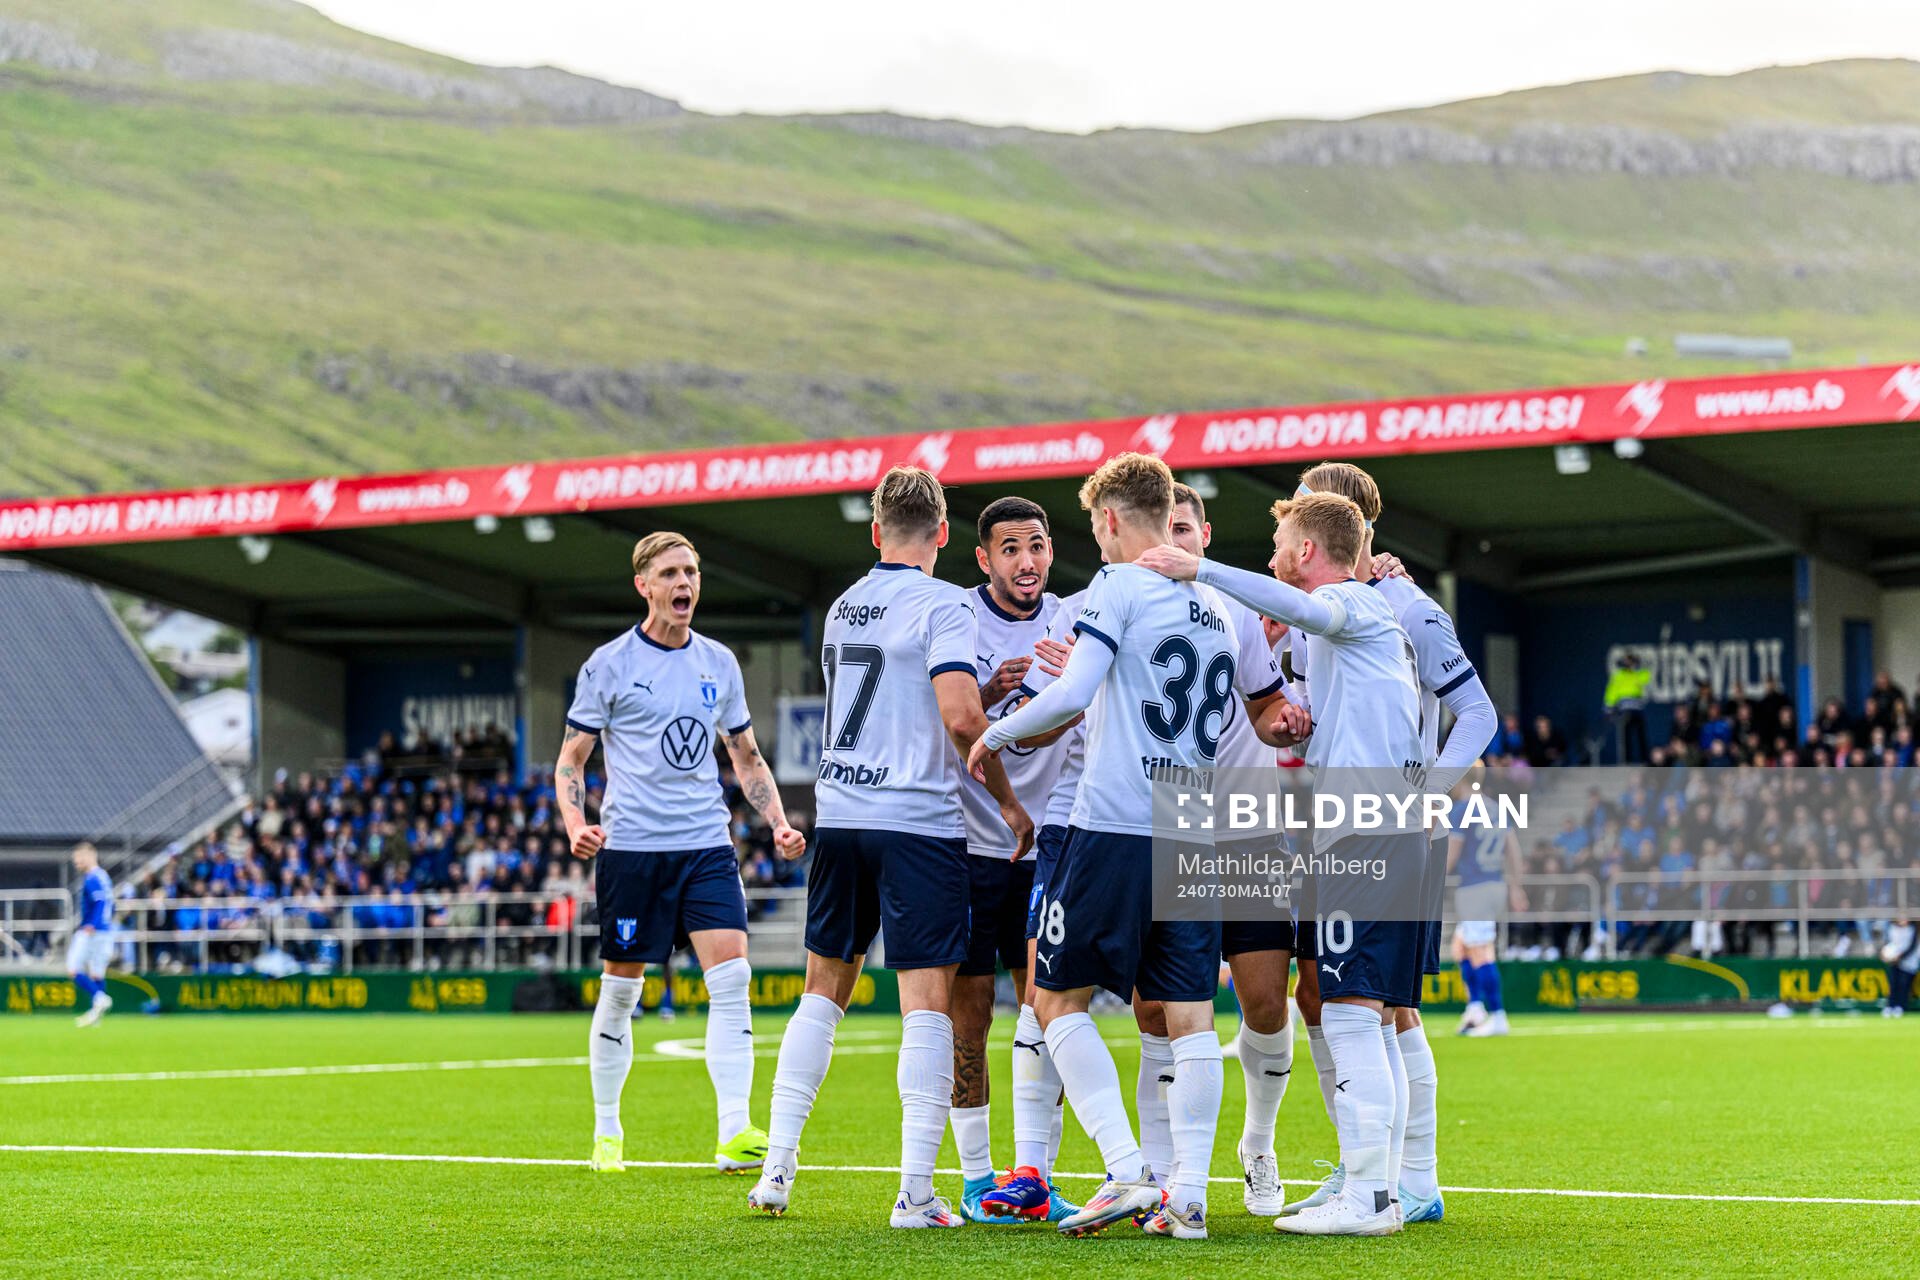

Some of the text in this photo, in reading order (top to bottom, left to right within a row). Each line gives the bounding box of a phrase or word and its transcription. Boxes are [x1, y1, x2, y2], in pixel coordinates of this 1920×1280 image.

[1376, 395, 1585, 443] SPARIKASSI
[704, 448, 882, 491] SPARIKASSI
[125, 490, 279, 531] SPARIKASSI
[834, 600, 888, 626] Stryger
[1189, 600, 1225, 633] Bolin
[823, 643, 885, 751] 17
[1142, 635, 1236, 761] 38
[1316, 909, 1354, 957] 10
[1576, 970, 1640, 1000] KSS
